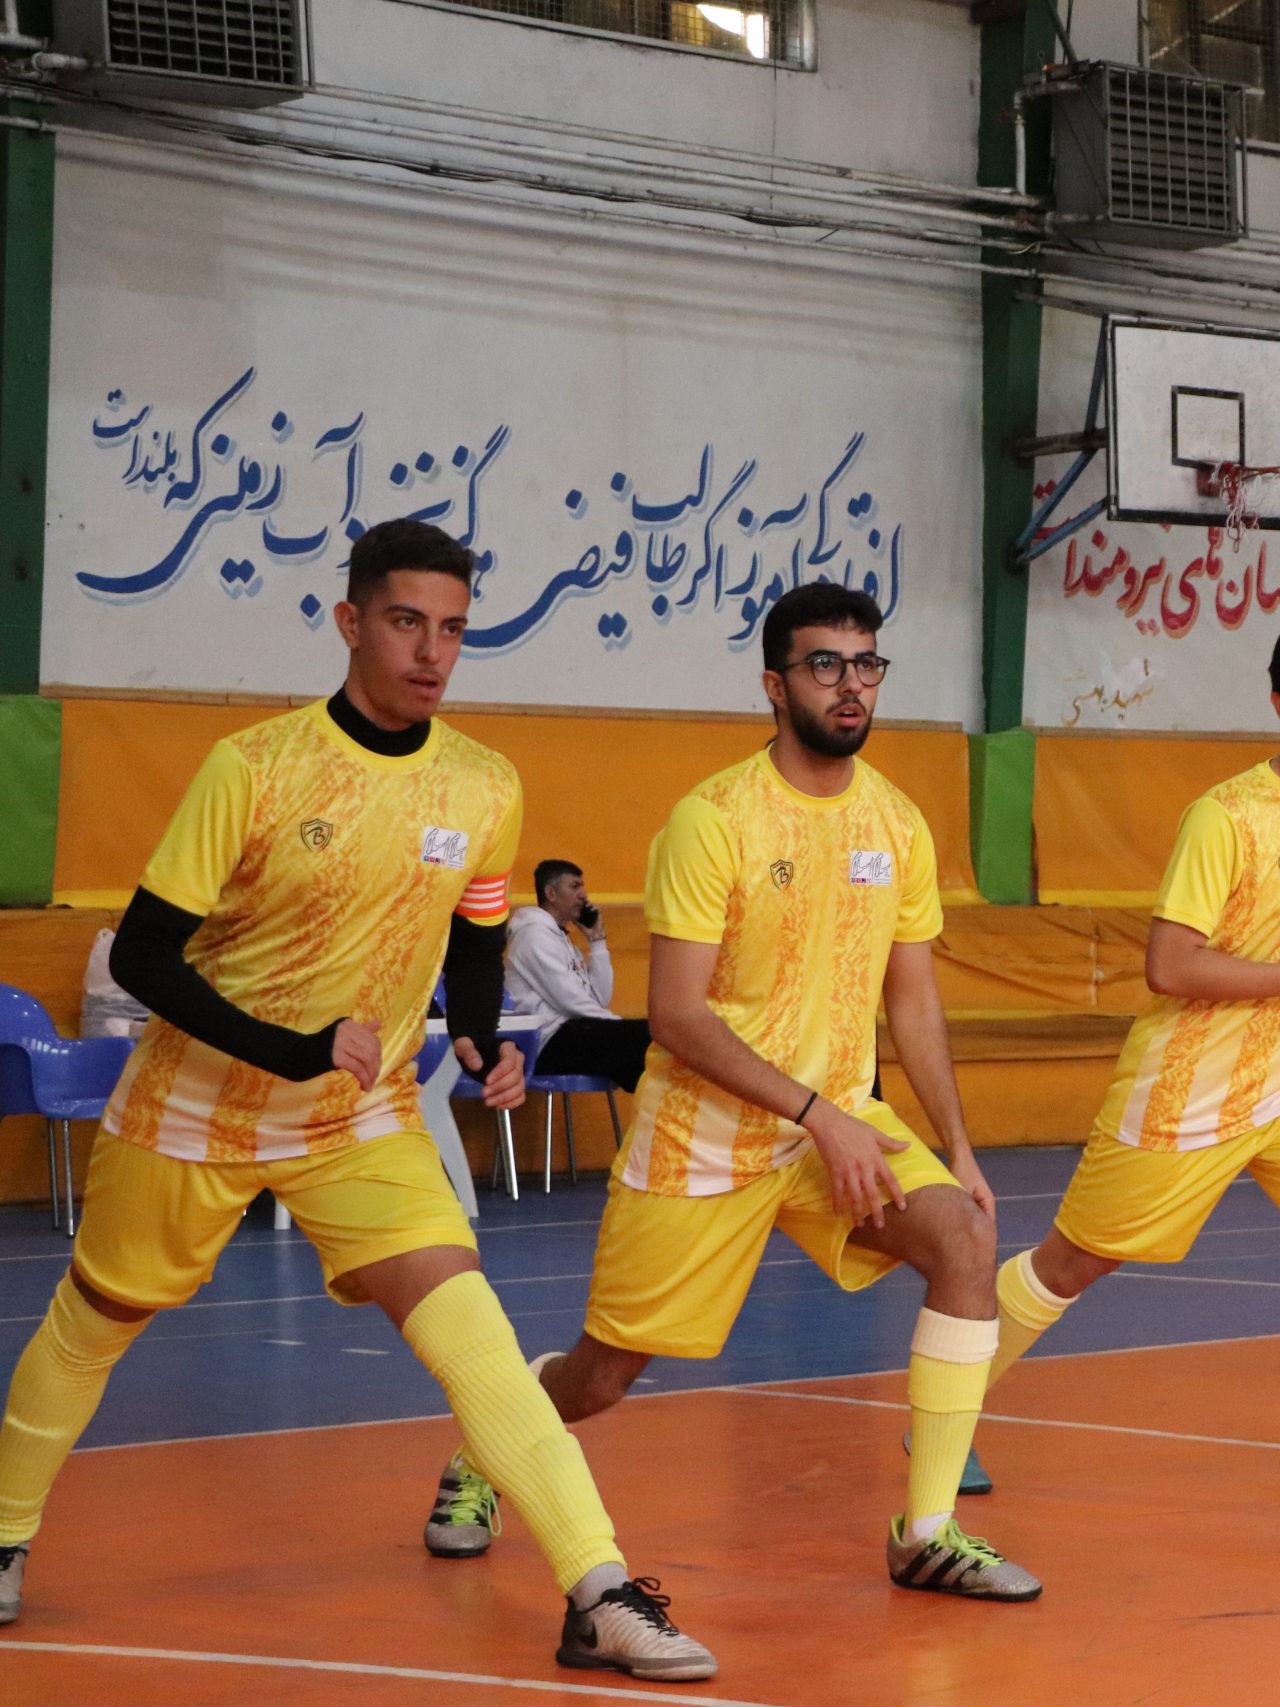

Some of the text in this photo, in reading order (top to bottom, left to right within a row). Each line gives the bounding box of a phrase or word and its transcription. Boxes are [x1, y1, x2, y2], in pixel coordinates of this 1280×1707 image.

[163, 366, 255, 510] که
[261, 410, 364, 620] آب
[806, 431, 902, 621] افتاگی
[630, 441, 712, 618] طالب
[676, 458, 757, 610] اگر
